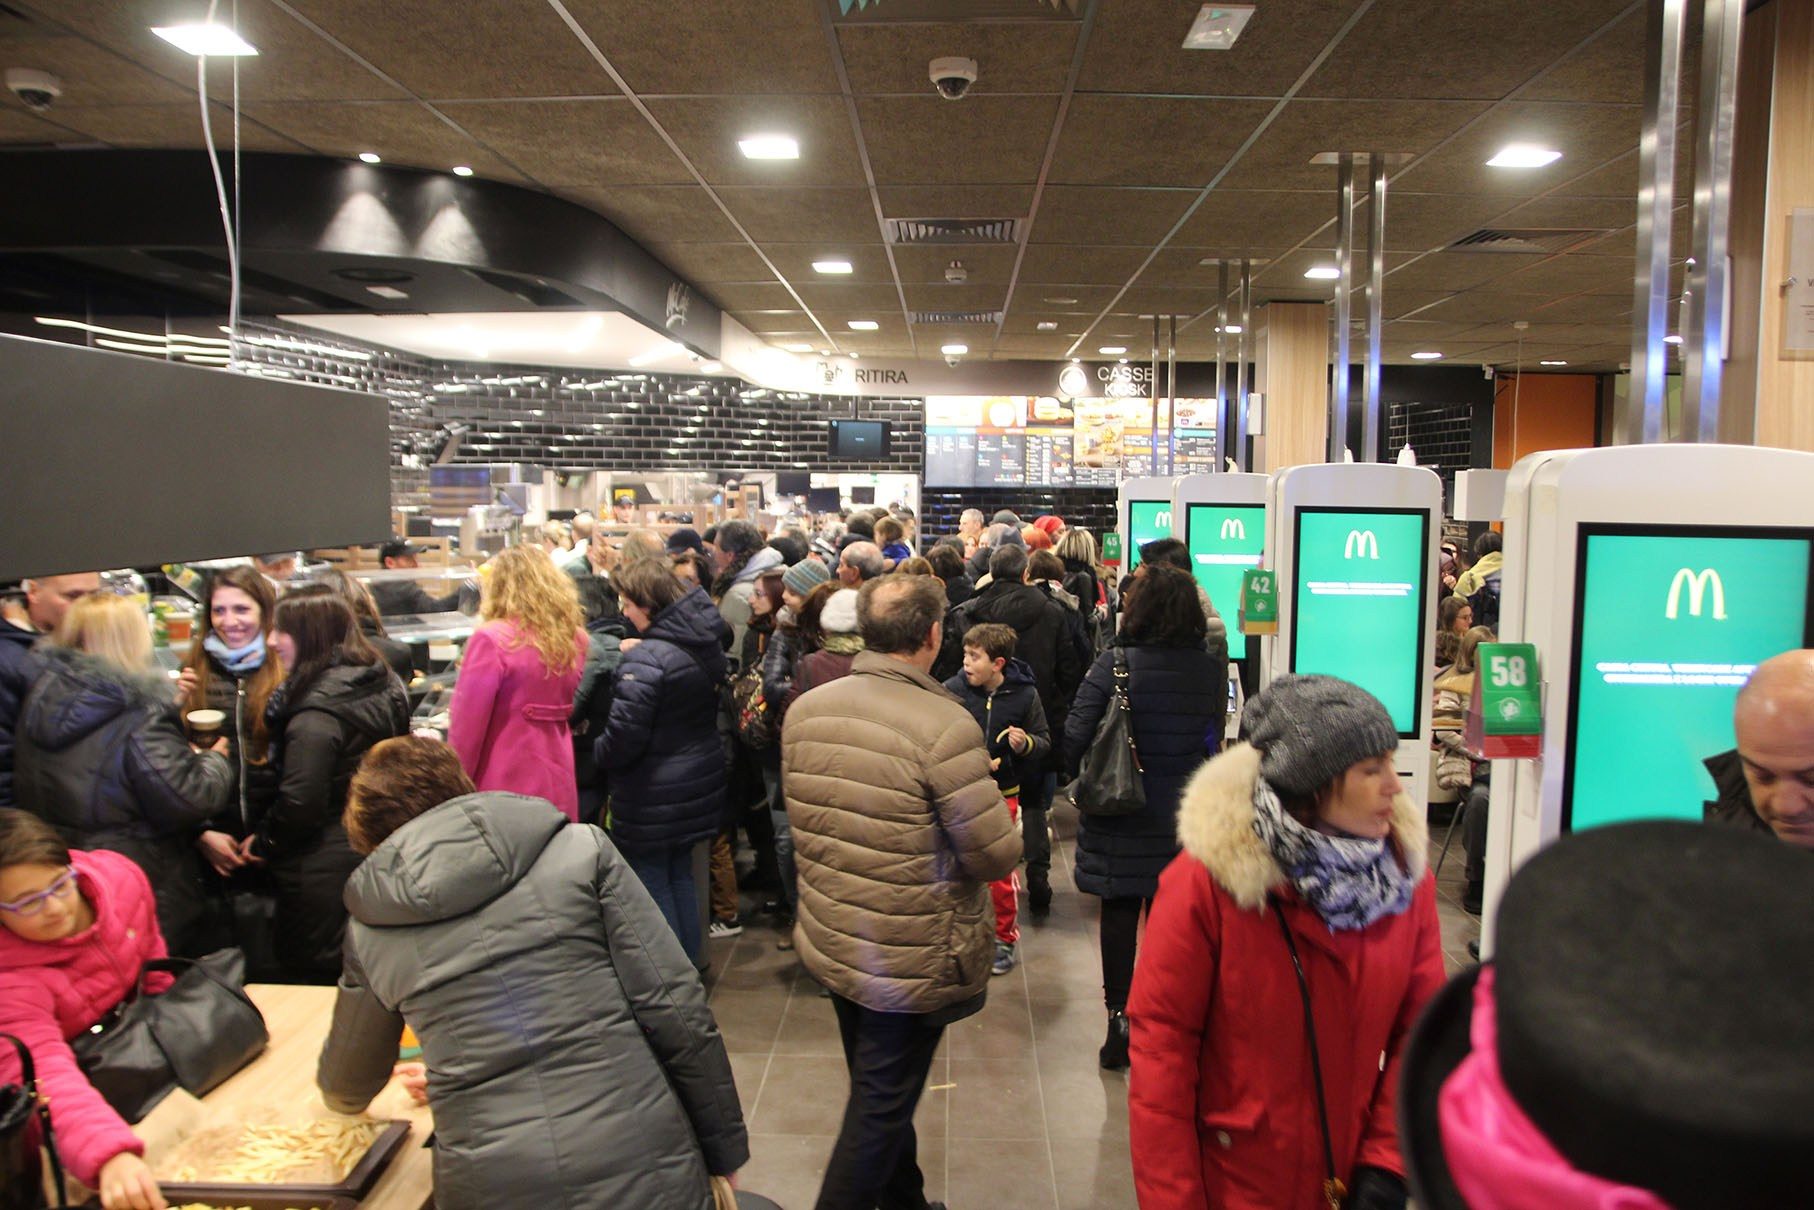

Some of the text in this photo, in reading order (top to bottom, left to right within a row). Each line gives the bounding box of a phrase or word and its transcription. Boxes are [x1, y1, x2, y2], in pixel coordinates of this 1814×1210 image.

[855, 368, 908, 384] RITIRA
[1097, 366, 1153, 382] CASSE
[1104, 383, 1147, 397] KIOSK
[1250, 576, 1271, 594] 42
[1491, 655, 1527, 687] 58
